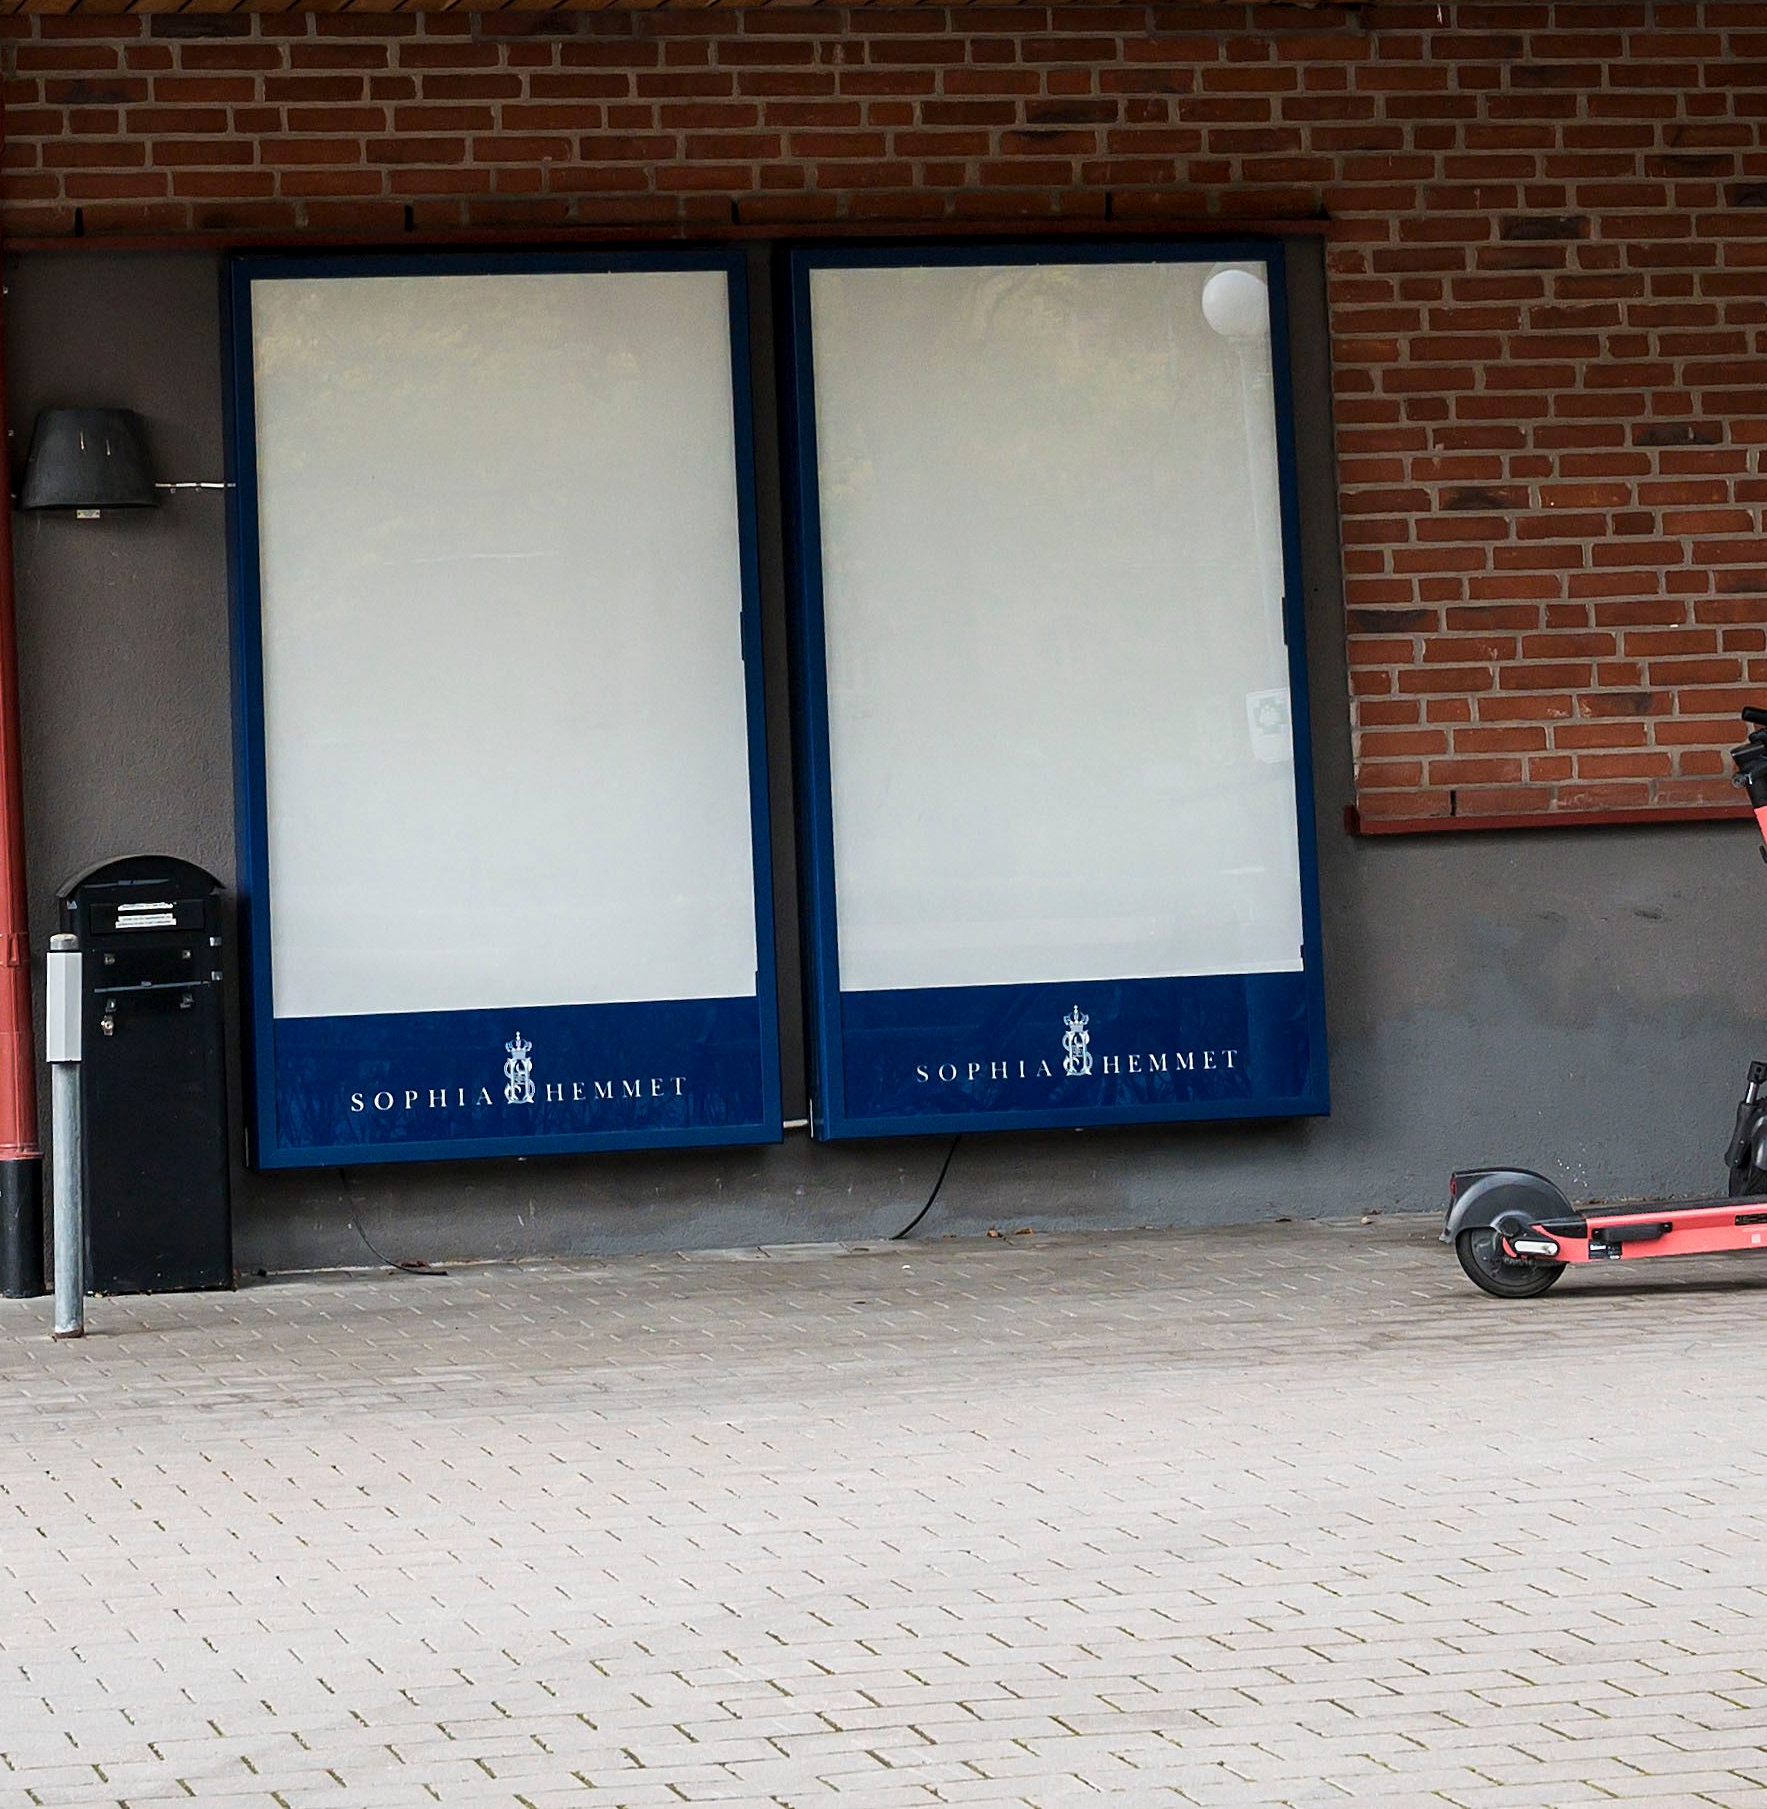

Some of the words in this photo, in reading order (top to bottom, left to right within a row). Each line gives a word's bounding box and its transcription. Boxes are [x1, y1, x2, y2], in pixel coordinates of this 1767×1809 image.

[915, 1059, 1054, 1084] SOPHIA
[1103, 1048, 1240, 1075] HEMMET
[350, 1088, 495, 1113] SOPHIA
[545, 1075, 688, 1103] HEMMET
